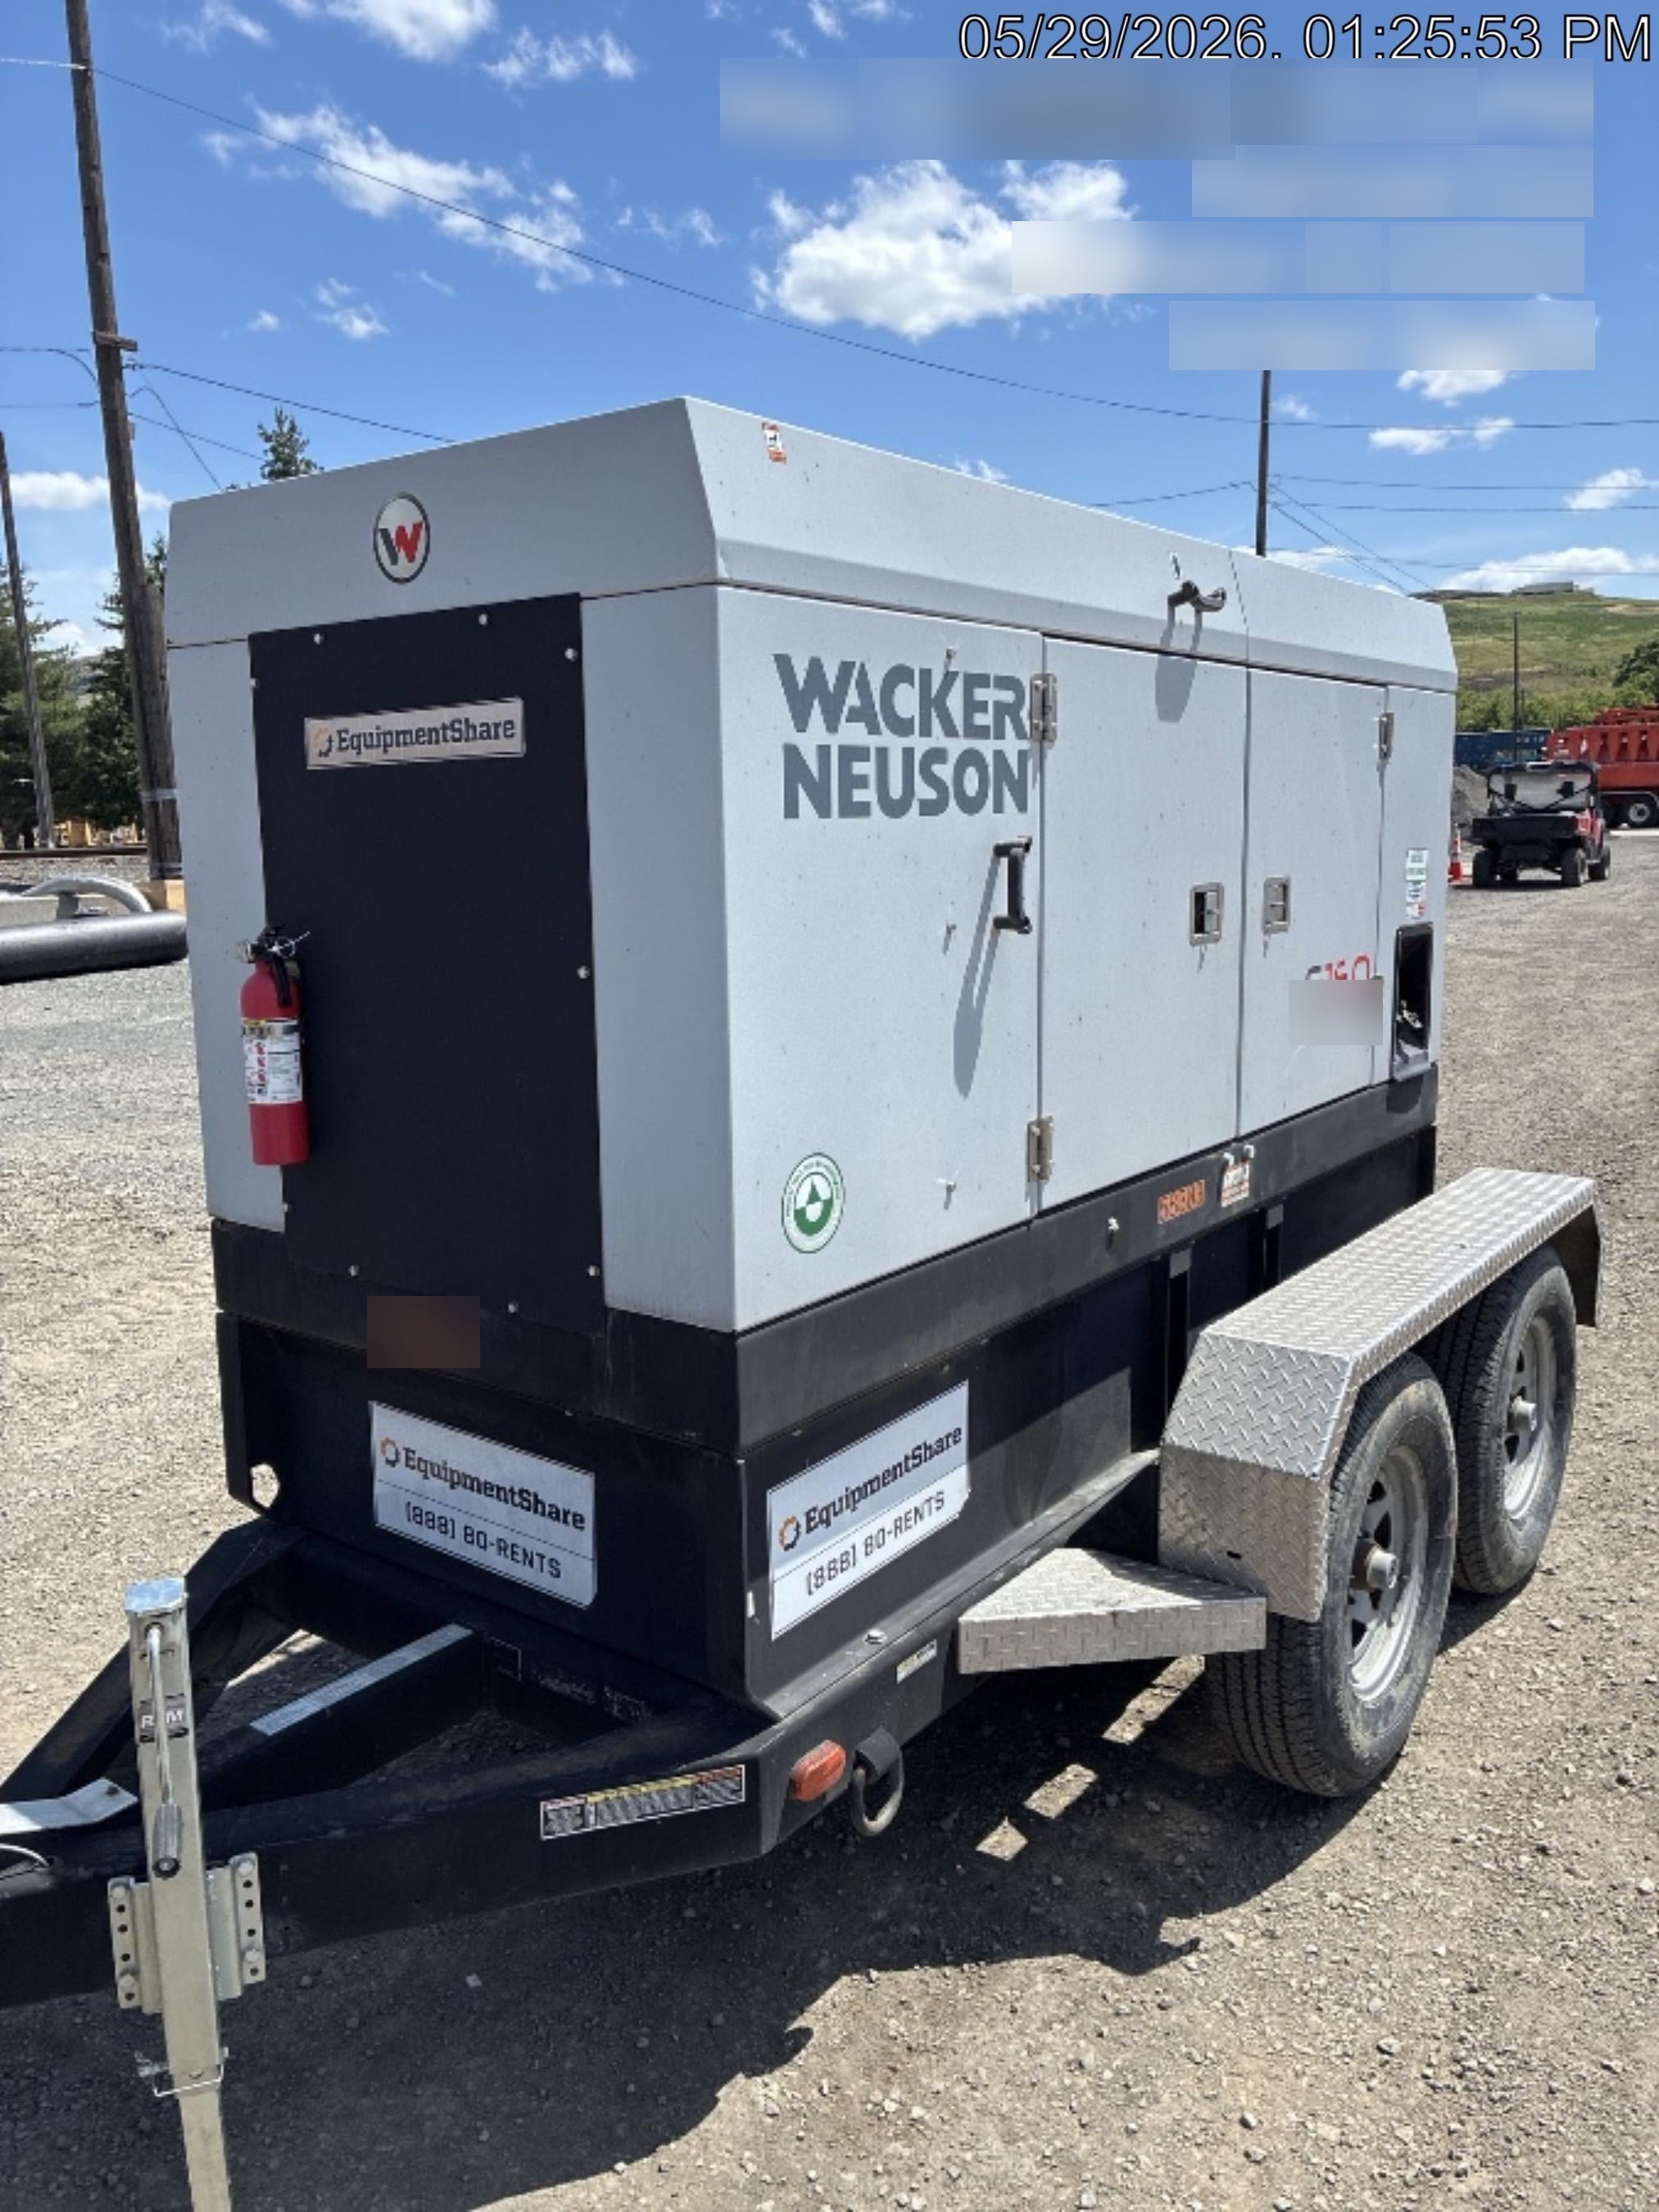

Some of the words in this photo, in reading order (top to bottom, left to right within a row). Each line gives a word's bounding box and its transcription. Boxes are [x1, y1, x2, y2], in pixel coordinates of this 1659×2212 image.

[773, 653, 1030, 741] WACKER
[336, 717, 516, 755] EquipmentShare
[782, 743, 1029, 820] NEUSON
[403, 1446, 586, 1532] EquipmentShare
[805, 1426, 963, 1534] EquipmentShare
[464, 1525, 562, 1580] 80-RENTS
[863, 1490, 945, 1557] 80-RENTS
